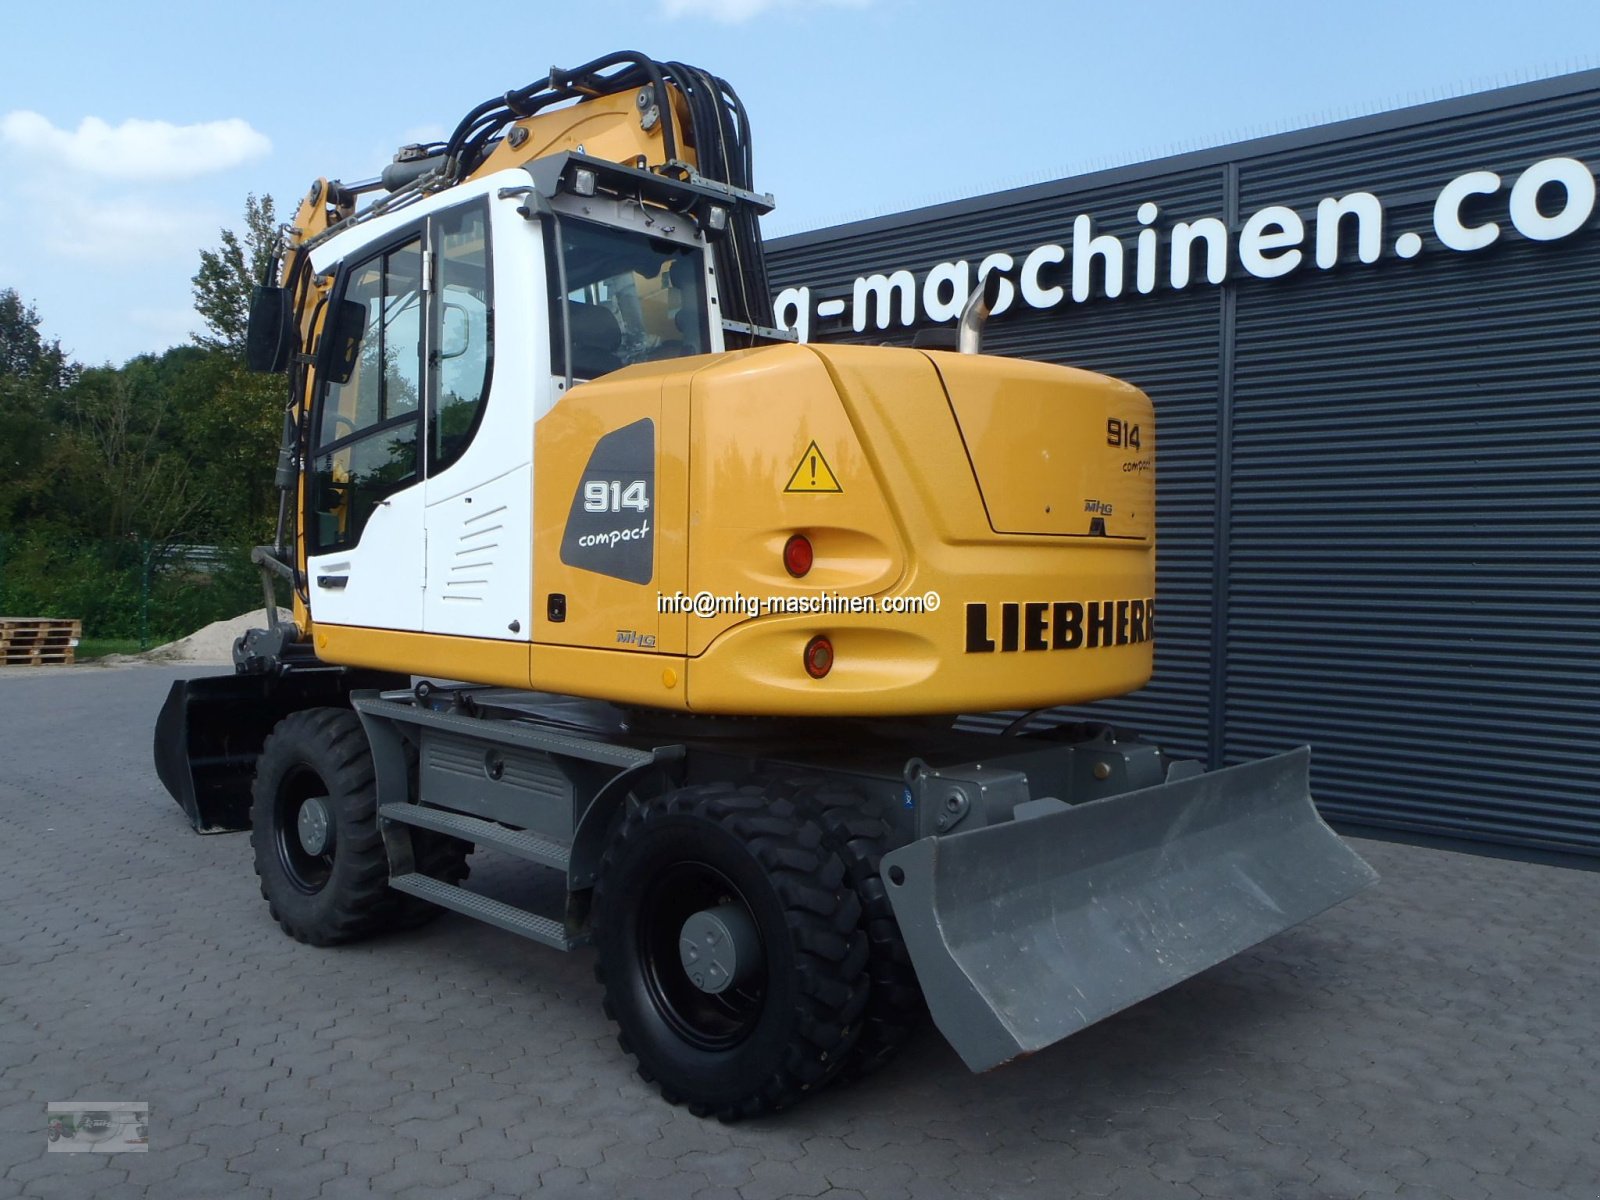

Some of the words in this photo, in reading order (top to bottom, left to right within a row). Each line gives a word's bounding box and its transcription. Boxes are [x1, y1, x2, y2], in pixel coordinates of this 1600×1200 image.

[1106, 417, 1141, 453] 914
[584, 480, 650, 513] 914
[1084, 499, 1113, 516] MHG
[578, 519, 650, 549] compact
[615, 630, 656, 648] MHG
